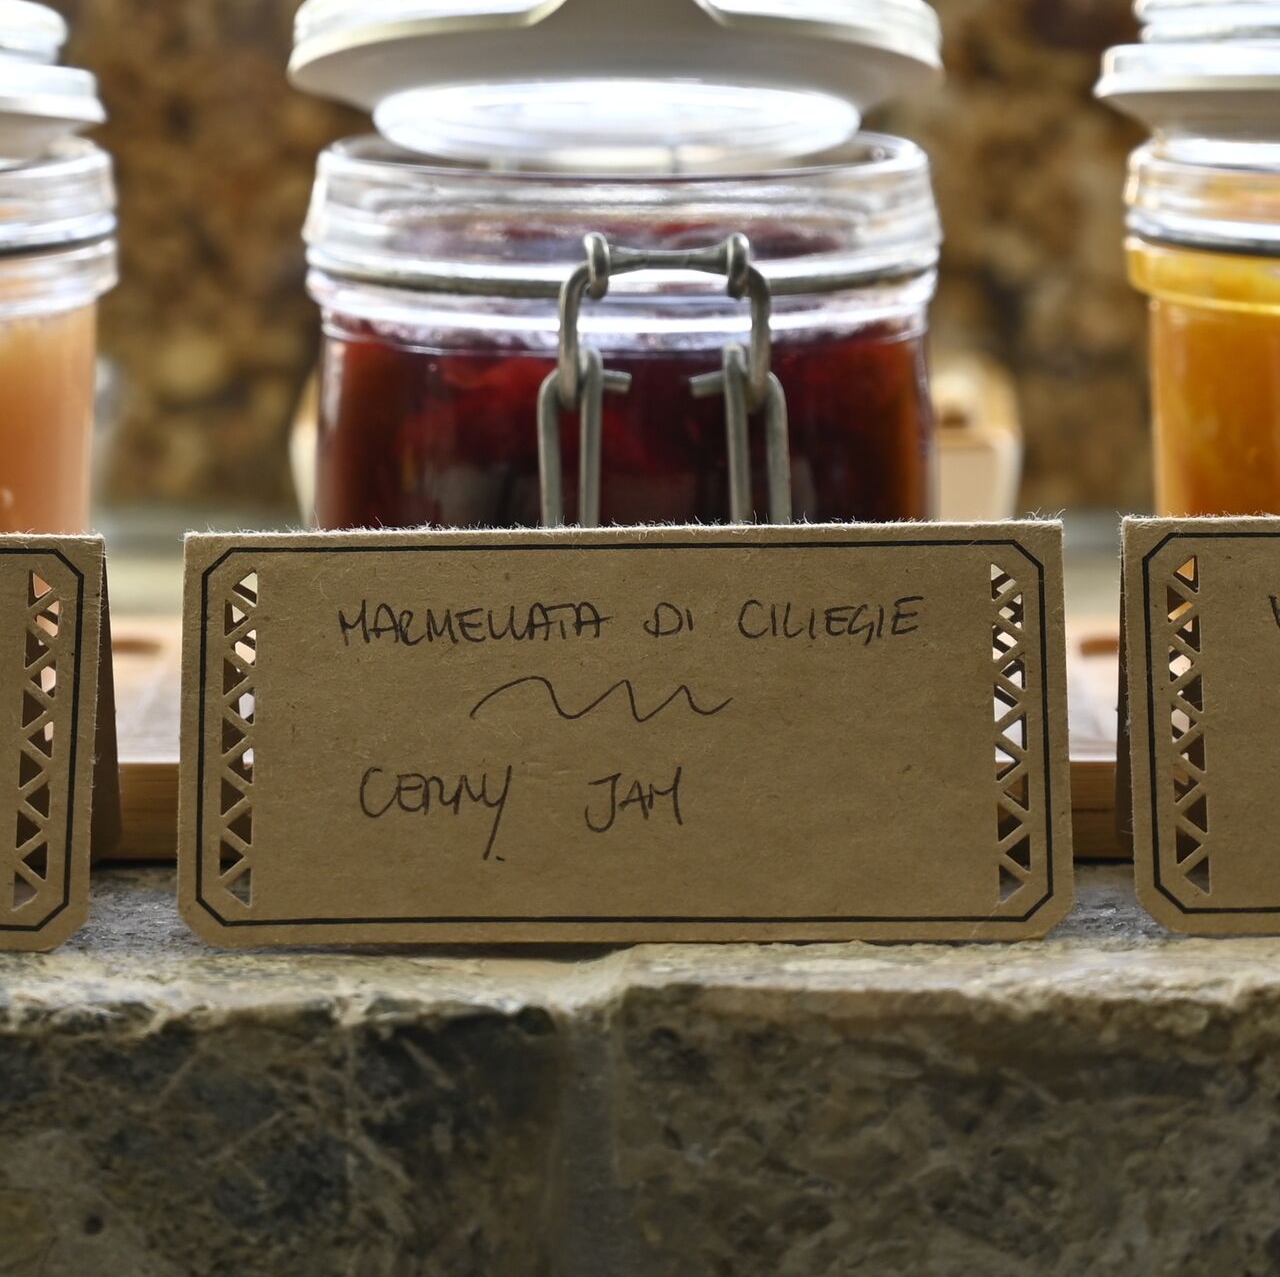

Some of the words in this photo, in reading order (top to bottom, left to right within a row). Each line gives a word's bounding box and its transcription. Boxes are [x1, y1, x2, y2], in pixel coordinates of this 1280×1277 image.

[642, 601, 694, 639] DI
[737, 595, 924, 646] CILIEGIE
[584, 766, 683, 833] JAM
